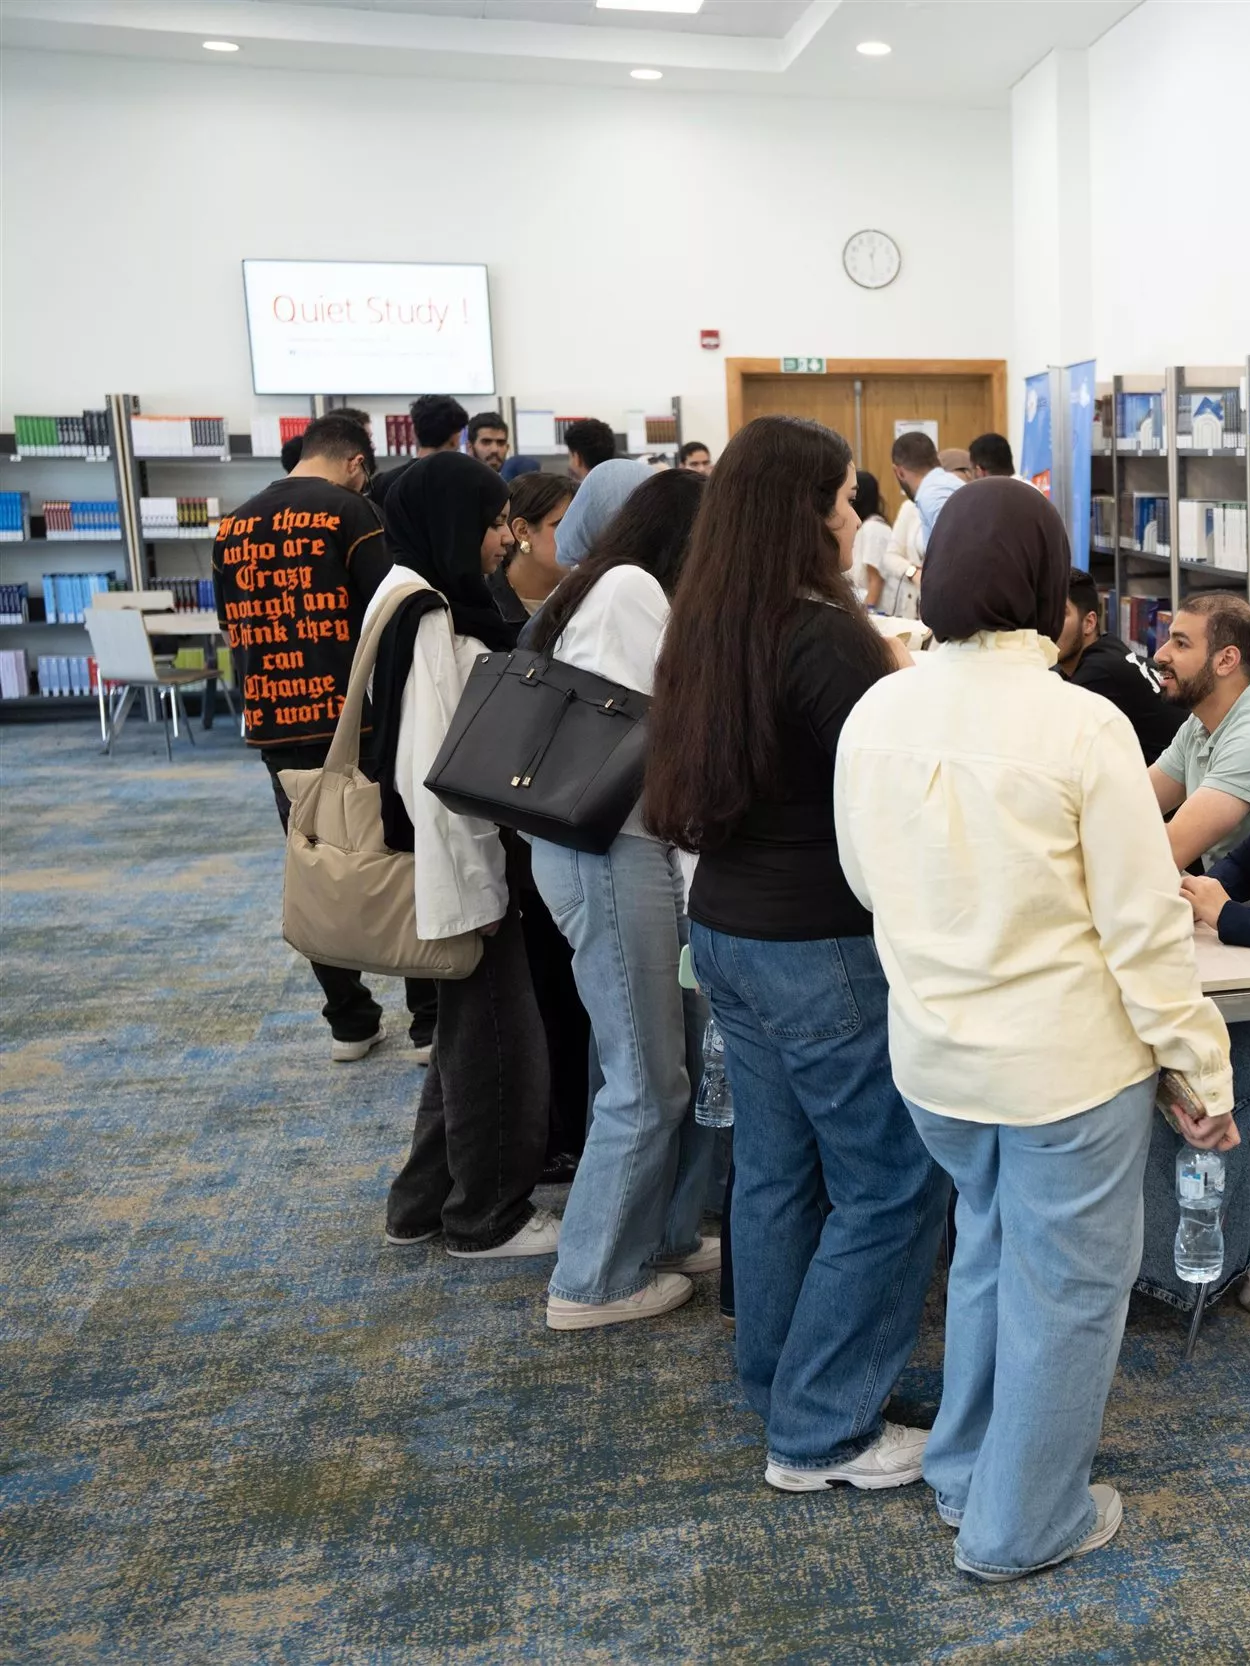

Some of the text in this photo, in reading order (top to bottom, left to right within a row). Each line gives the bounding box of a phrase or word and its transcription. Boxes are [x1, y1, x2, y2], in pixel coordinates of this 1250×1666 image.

[273, 294, 356, 324] Quiet
[367, 296, 448, 332] Study
[216, 507, 341, 541] For those
[223, 538, 325, 567] who are
[236, 564, 313, 591] Crazy
[226, 587, 348, 621] nough and
[228, 616, 349, 649] Think they
[262, 651, 304, 670] can
[244, 674, 335, 702] Change
[244, 709, 264, 731] he
